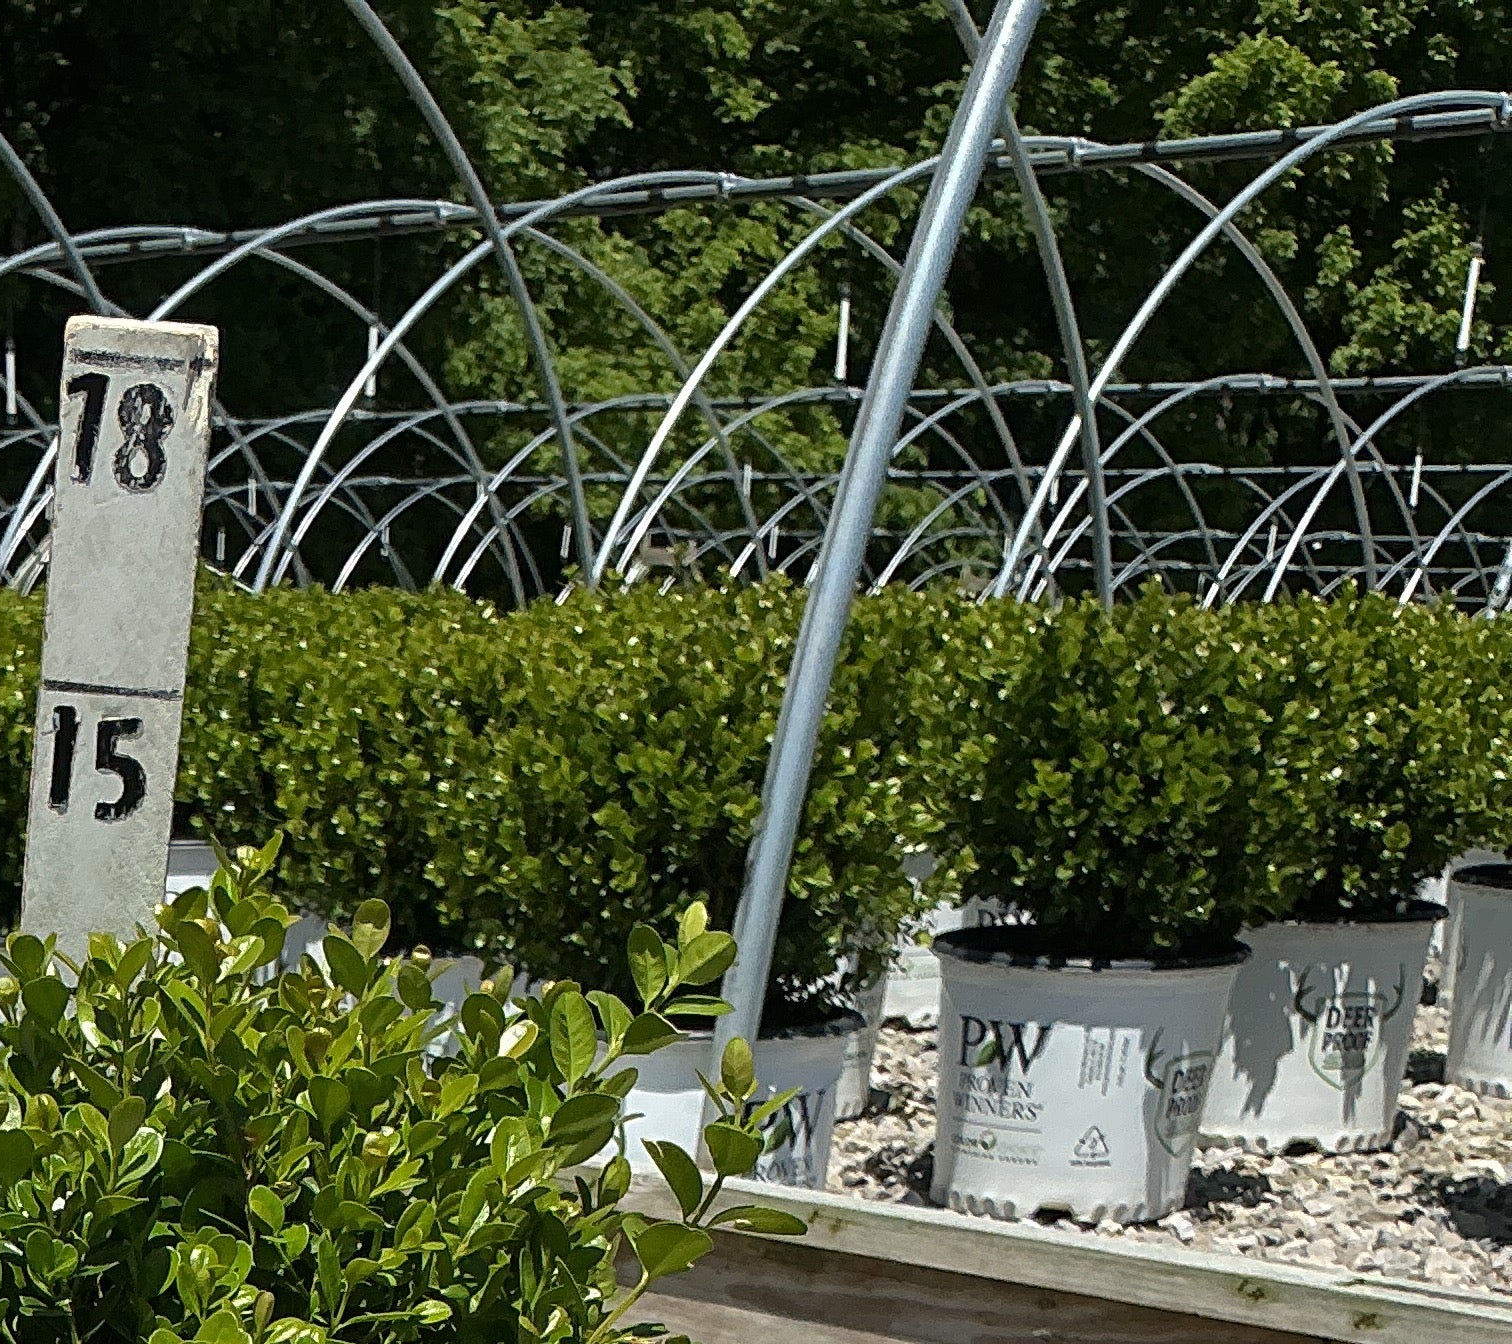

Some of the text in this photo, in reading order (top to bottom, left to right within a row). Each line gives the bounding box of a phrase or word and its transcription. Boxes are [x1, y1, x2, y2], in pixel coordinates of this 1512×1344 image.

[67, 372, 176, 492] 18
[48, 704, 147, 823] 15
[1326, 1005, 1377, 1029] DEER
[960, 1014, 1052, 1076] PW
[1322, 1031, 1373, 1053] PROOF
[959, 1071, 1034, 1098] PROVEN
